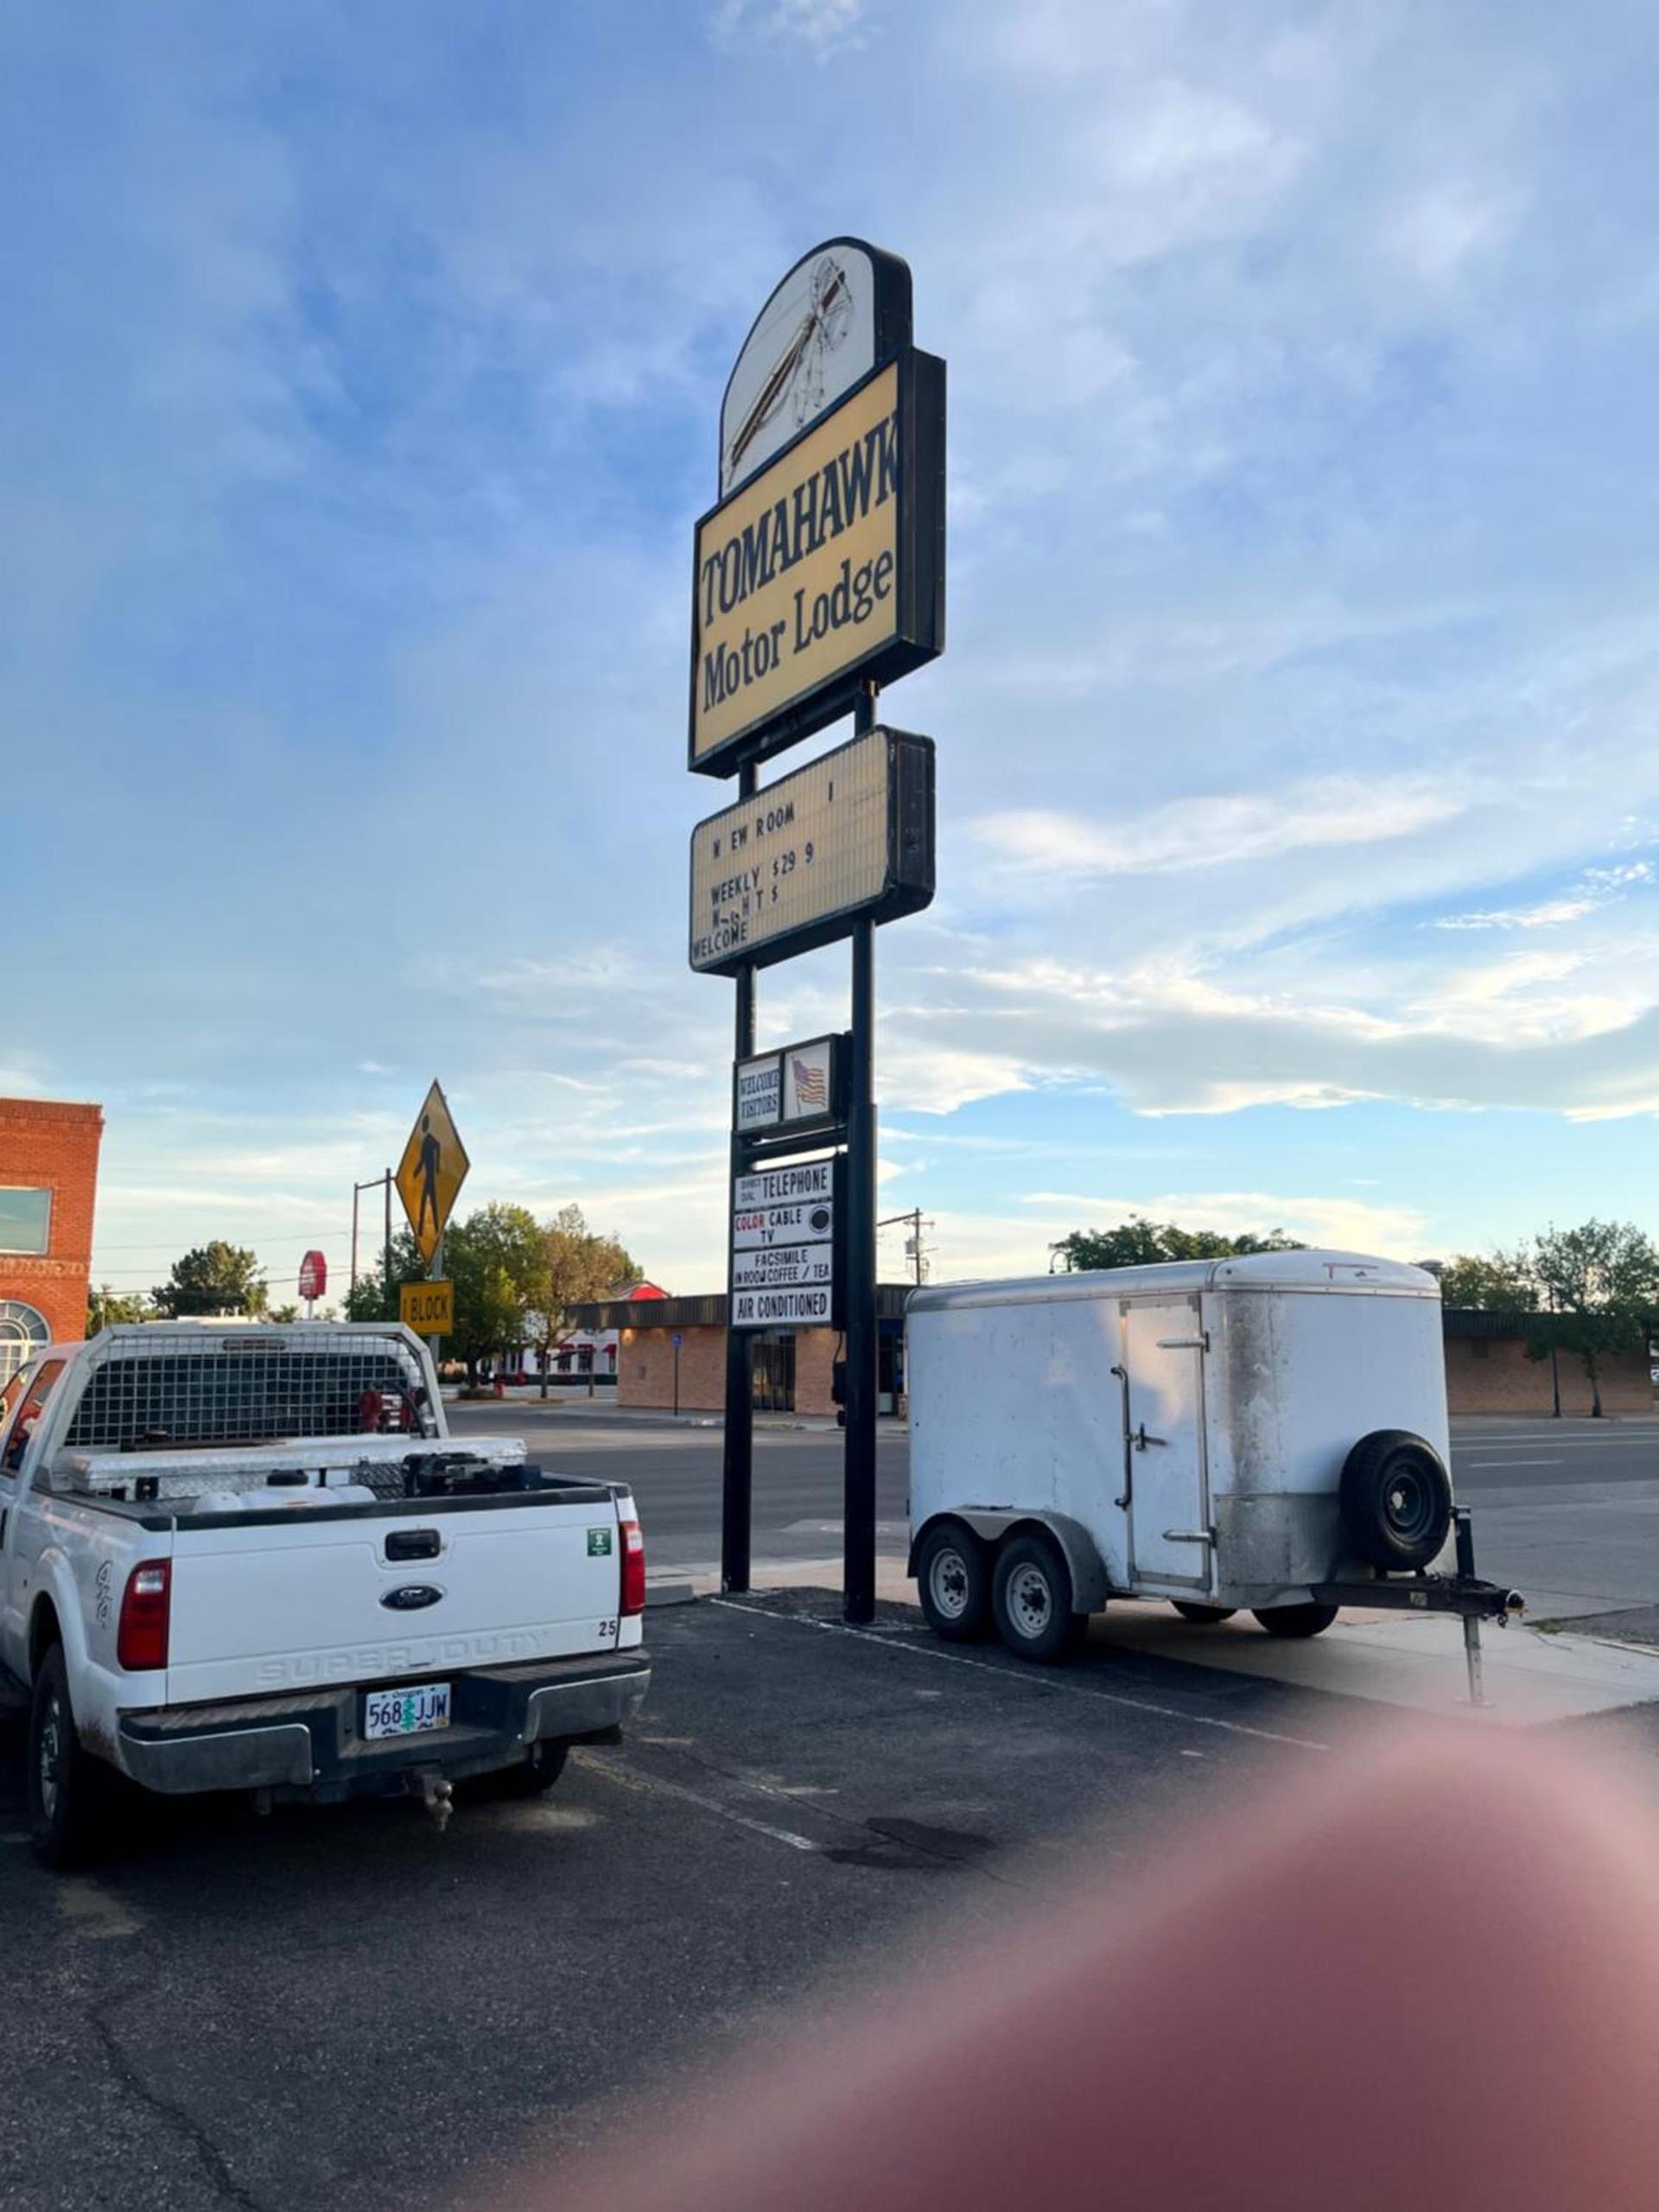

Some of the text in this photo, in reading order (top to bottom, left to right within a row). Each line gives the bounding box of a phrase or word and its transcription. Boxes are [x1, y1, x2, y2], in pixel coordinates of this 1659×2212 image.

[702, 412, 897, 628] TOMAHAWK
[702, 549, 893, 714] Motor Lodge
[756, 803, 794, 837] ROOM
[711, 867, 760, 906] WEEKLY
[772, 851, 796, 877] $29
[694, 921, 747, 959] WELCOME
[762, 1167, 827, 1198] TELEPHONE
[736, 1209, 802, 1231] COLOR CABLE
[761, 1229, 774, 1243] TV
[755, 1249, 807, 1268] FACSIMILE
[767, 1266, 798, 1282] COFFEE
[813, 1263, 830, 1279] TEA
[410, 1294, 449, 1322] BLOCK
[737, 1293, 827, 1319] AIR CONDITIONED
[599, 1620, 616, 1637] 25
[259, 1632, 542, 1685] SUPER DUTY
[370, 1694, 447, 1727] 568 JJW
